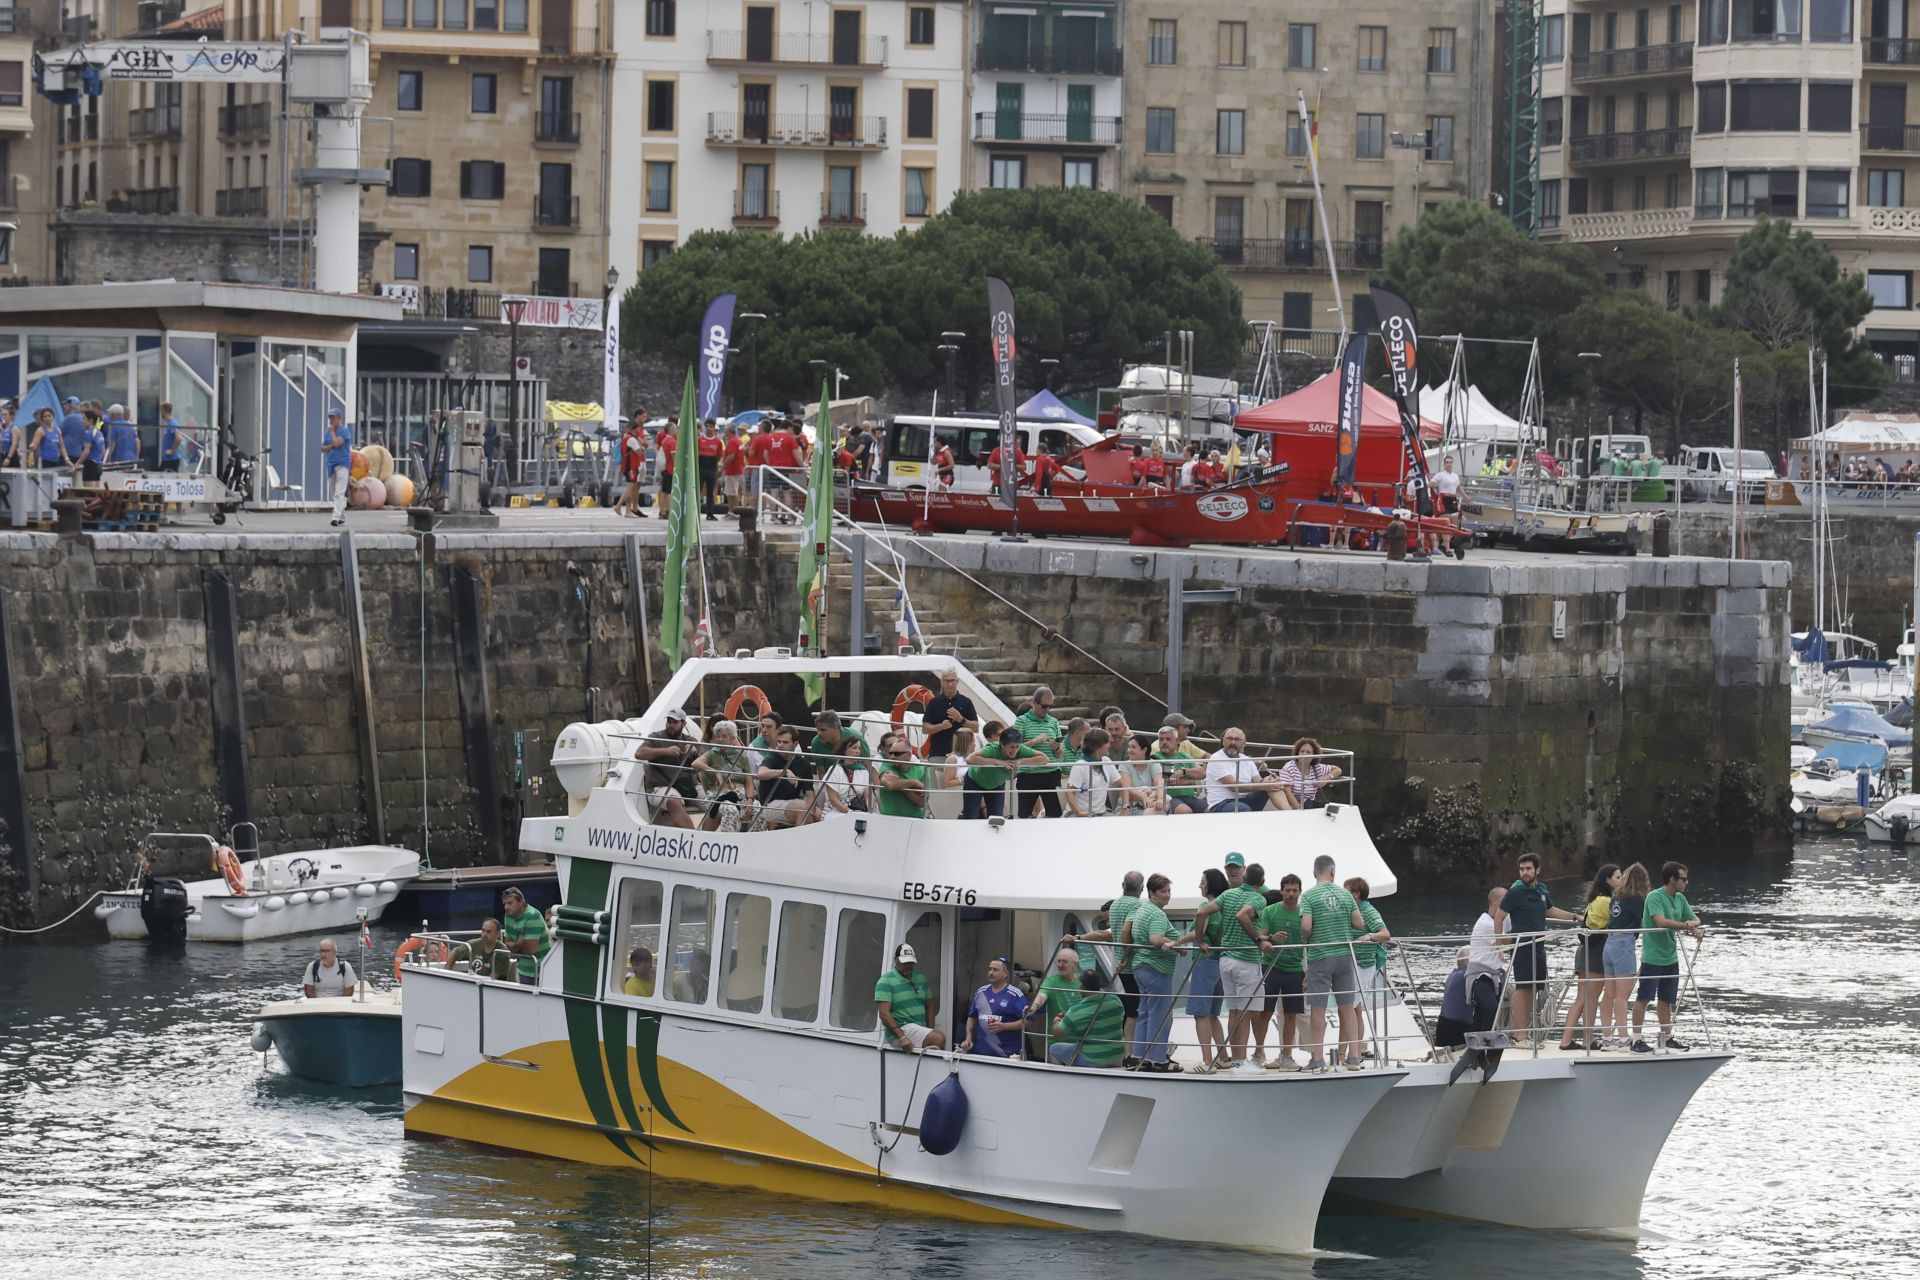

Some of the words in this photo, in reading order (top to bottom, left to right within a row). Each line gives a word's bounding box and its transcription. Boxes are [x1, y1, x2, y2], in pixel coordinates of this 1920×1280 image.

[125, 50, 160, 67] GH
[221, 50, 258, 69] ekp
[703, 324, 729, 375] ekp
[997, 310, 1010, 386] DELTECO
[1308, 423, 1335, 433] SANZ
[176, 481, 204, 496] Tolosa
[1198, 501, 1247, 512] DELTECO
[588, 827, 739, 865] www.jolaski.com
[903, 882, 977, 906] EB-5716
